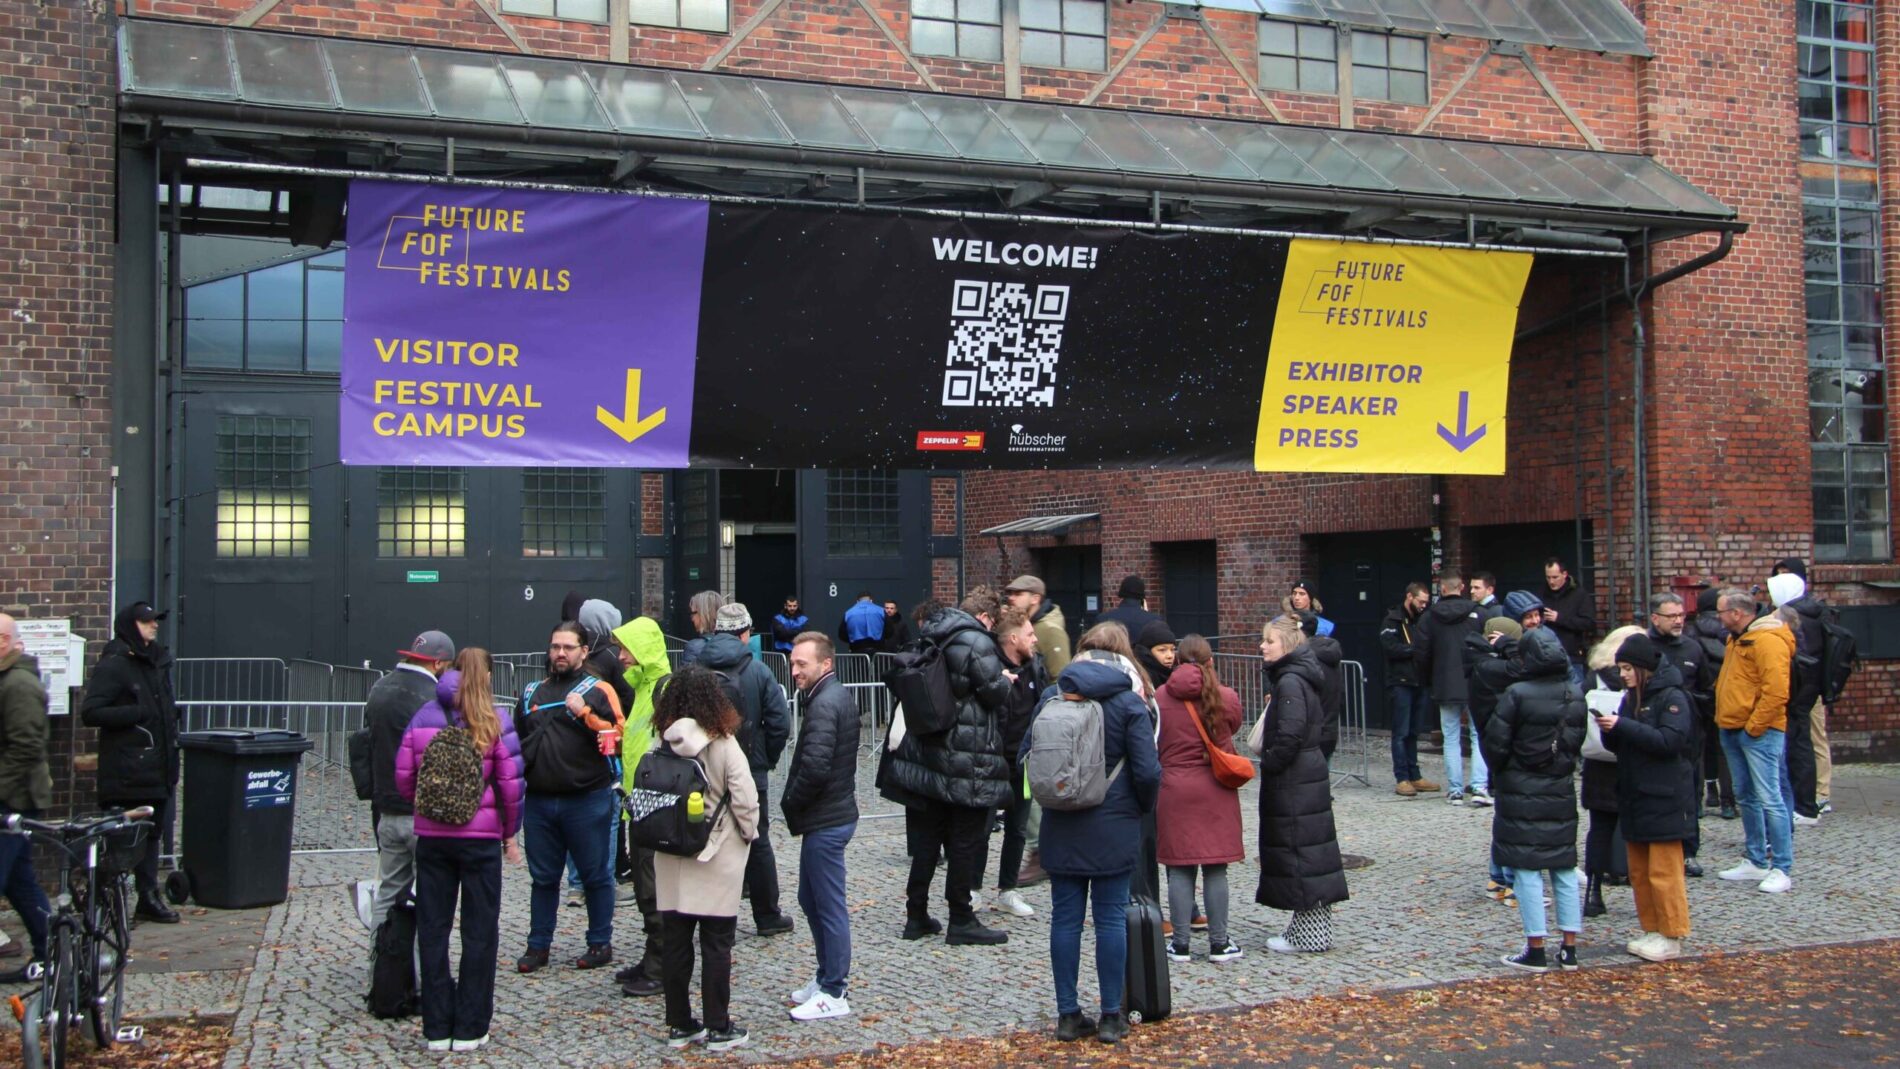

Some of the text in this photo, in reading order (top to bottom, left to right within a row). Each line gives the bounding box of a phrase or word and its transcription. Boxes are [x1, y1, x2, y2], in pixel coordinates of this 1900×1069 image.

[423, 204, 525, 233] FUTURE
[401, 231, 453, 257] FOF
[932, 237, 1099, 269] WELCOME!
[419, 261, 571, 292] FESTIVALS
[1335, 260, 1405, 282] FUTURE
[1317, 283, 1354, 302] FOF
[1326, 307, 1428, 328] FESTIVALS
[374, 338, 520, 367] VISITOR
[1288, 361, 1423, 384] EXHIBITOR
[374, 379, 542, 408] FESTIVAL
[1282, 394, 1398, 416] SPEAKER
[373, 411, 526, 438] CAMPUS
[922, 437, 959, 445] ZEPPELIN
[1009, 433, 1067, 446] hübscher
[1278, 428, 1359, 448] PRESS
[524, 587, 534, 601] 9
[829, 584, 838, 597] 8
